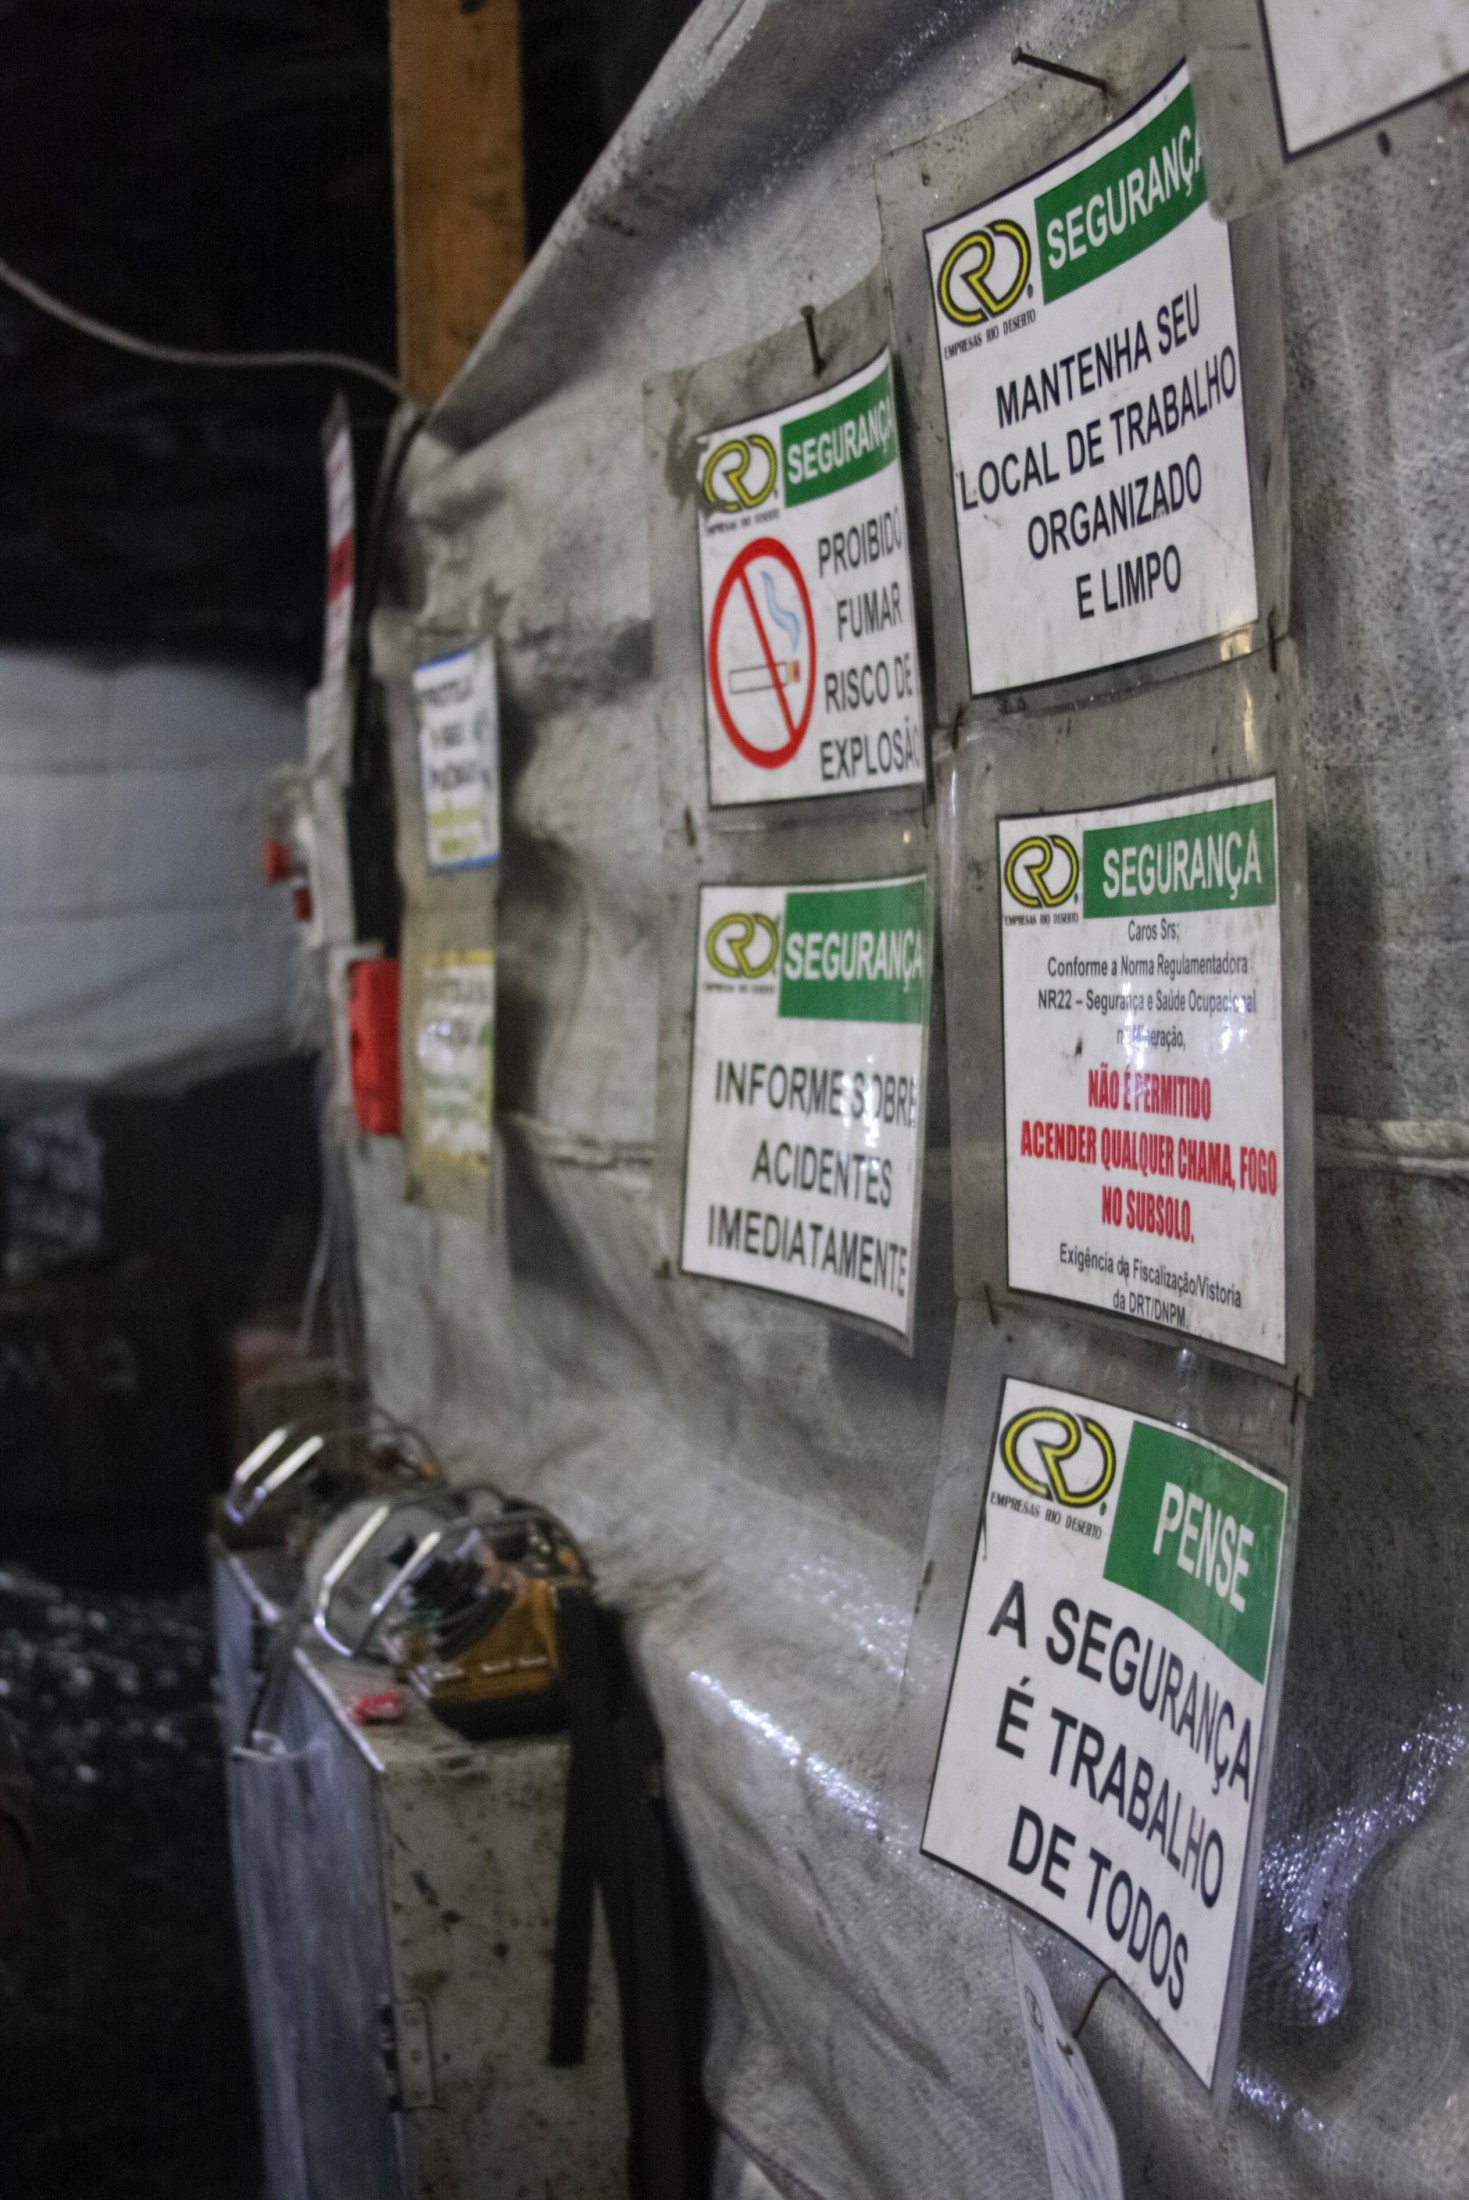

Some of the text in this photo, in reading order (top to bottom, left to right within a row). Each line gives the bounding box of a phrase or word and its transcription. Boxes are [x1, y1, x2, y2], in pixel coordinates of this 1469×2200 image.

[944, 309, 1036, 360] EMPRESAS RIO DESERTO
[996, 284, 1200, 429] MANTENHA SEU
[959, 346, 1237, 511] LOCAL DE TRABALHO
[1028, 453, 1202, 560] ORGANIZADO
[837, 581, 902, 642] FUMAR
[1076, 544, 1182, 620] E LIMPO
[825, 652, 914, 714] RISCO DE
[1102, 829, 1262, 901] SEGURANÇA
[784, 928, 924, 993] SEGURANÇA
[1128, 919, 1180, 943] Caros Srs;
[1047, 952, 1248, 981] Conforme a Norma Regulamentadora
[1038, 989, 1072, 1010] NR22
[1086, 988, 1144, 1016] Segurança
[1147, 996, 1153, 1011] e
[1155, 988, 1185, 1012] Saúde
[715, 1061, 845, 1117] INFORME
[1088, 1061, 1211, 1121] NÃO É PERMITIDO
[752, 1140, 893, 1208] ACIDENTES
[1020, 1120, 1278, 1197] ACENDER QUALQUER CHAMA, FOGO
[1101, 1185, 1195, 1243] NO SUBSOLO.
[708, 1205, 907, 1298] IMEDIATAMENTE
[1059, 1242, 1114, 1273] Exigência
[1133, 1258, 1242, 1309] Fiscalização/Vistoria
[1113, 1289, 1189, 1329] da DRT/DNPM.
[990, 1491, 1102, 1541] EMPRESAS RIO DESERTO
[1153, 1482, 1255, 1613] PENSE
[987, 1580, 1252, 1802] A SEGURANÇA
[995, 1676, 1224, 1908] É TRABALHO
[1007, 1804, 1188, 2011] DE TODOS
